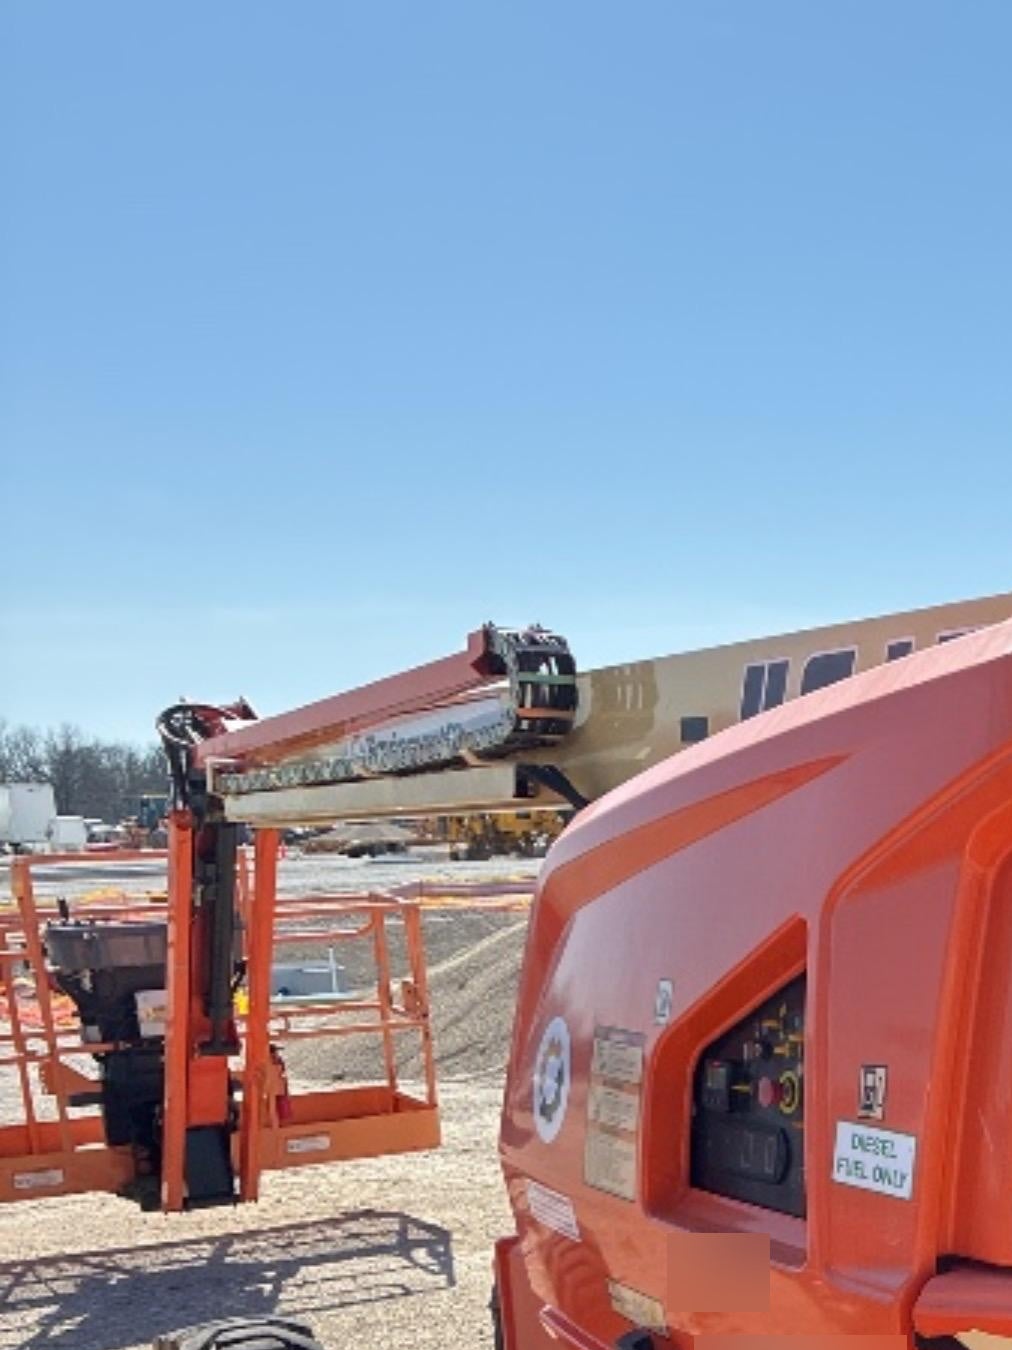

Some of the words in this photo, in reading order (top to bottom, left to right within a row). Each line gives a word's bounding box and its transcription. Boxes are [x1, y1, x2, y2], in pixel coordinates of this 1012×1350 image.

[851, 1132, 898, 1159] DIESEL
[837, 1158, 868, 1179] FUEL
[872, 1165, 908, 1189] ONLY
